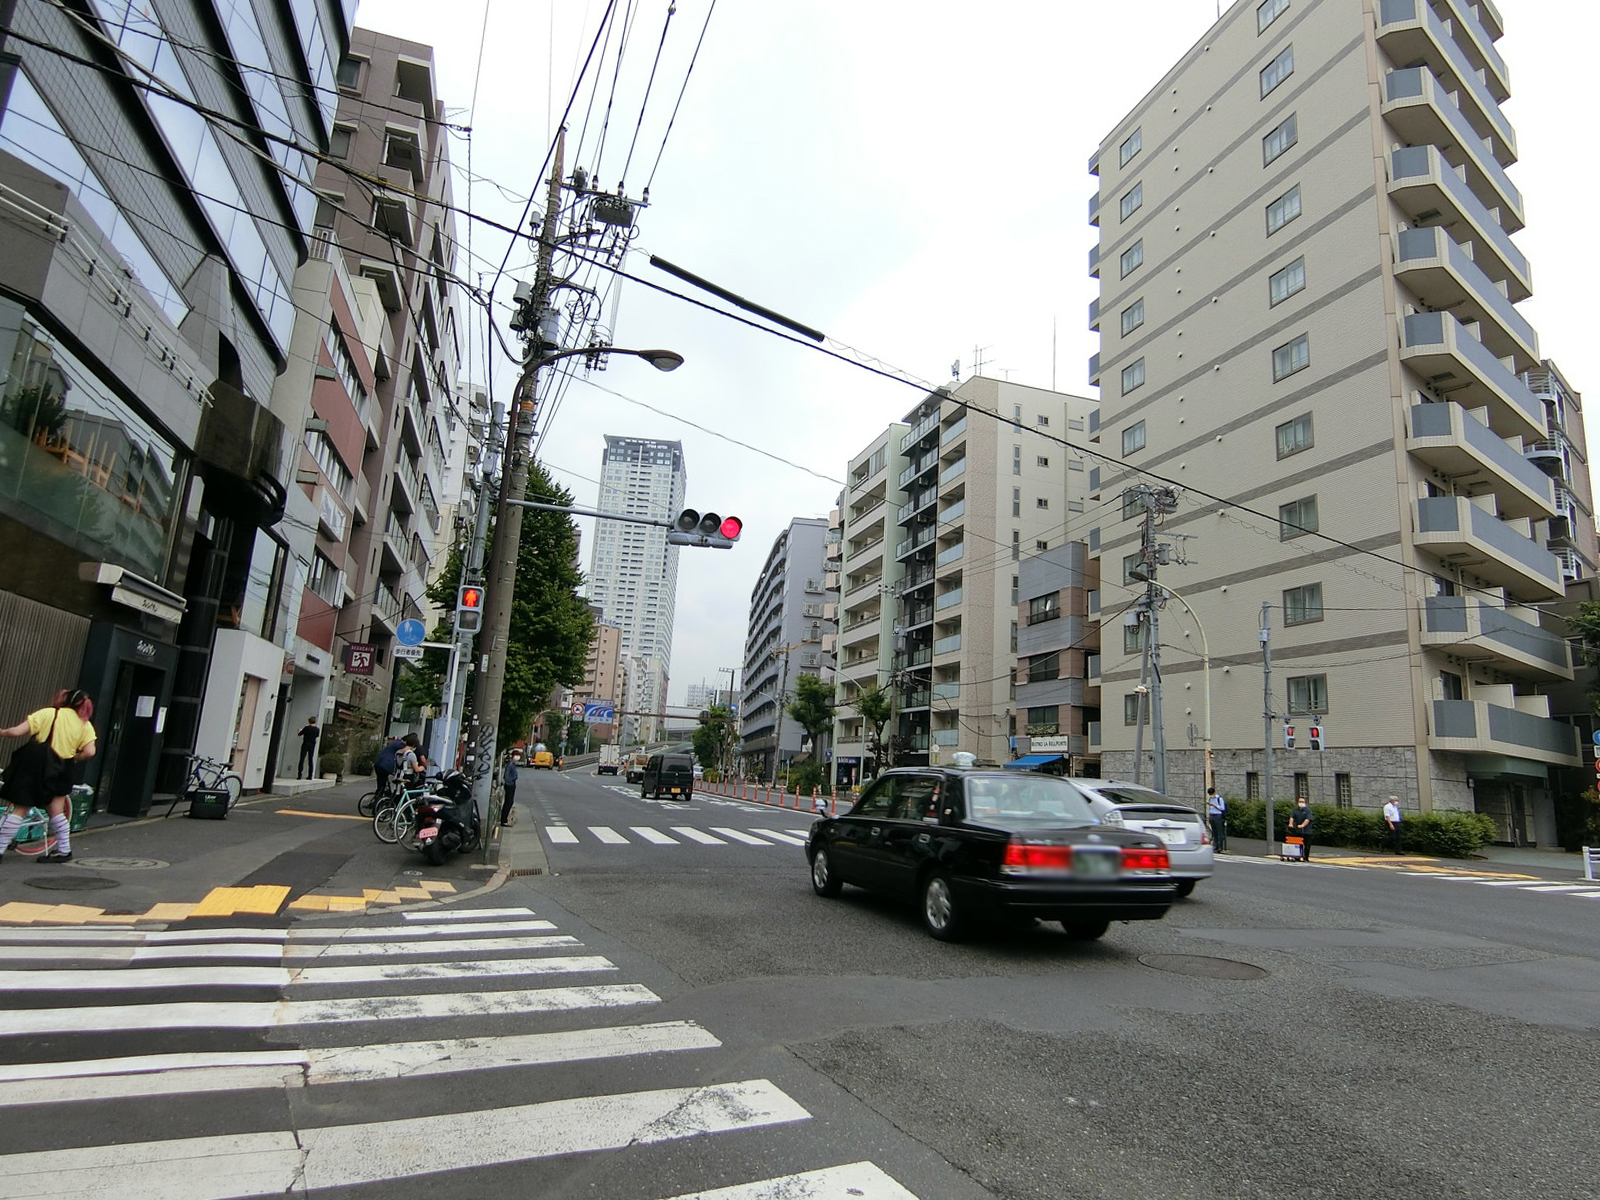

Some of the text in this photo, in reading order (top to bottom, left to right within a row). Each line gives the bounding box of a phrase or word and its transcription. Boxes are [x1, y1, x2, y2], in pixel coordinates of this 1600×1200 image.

[395, 648, 421, 656] 歩行者優先
